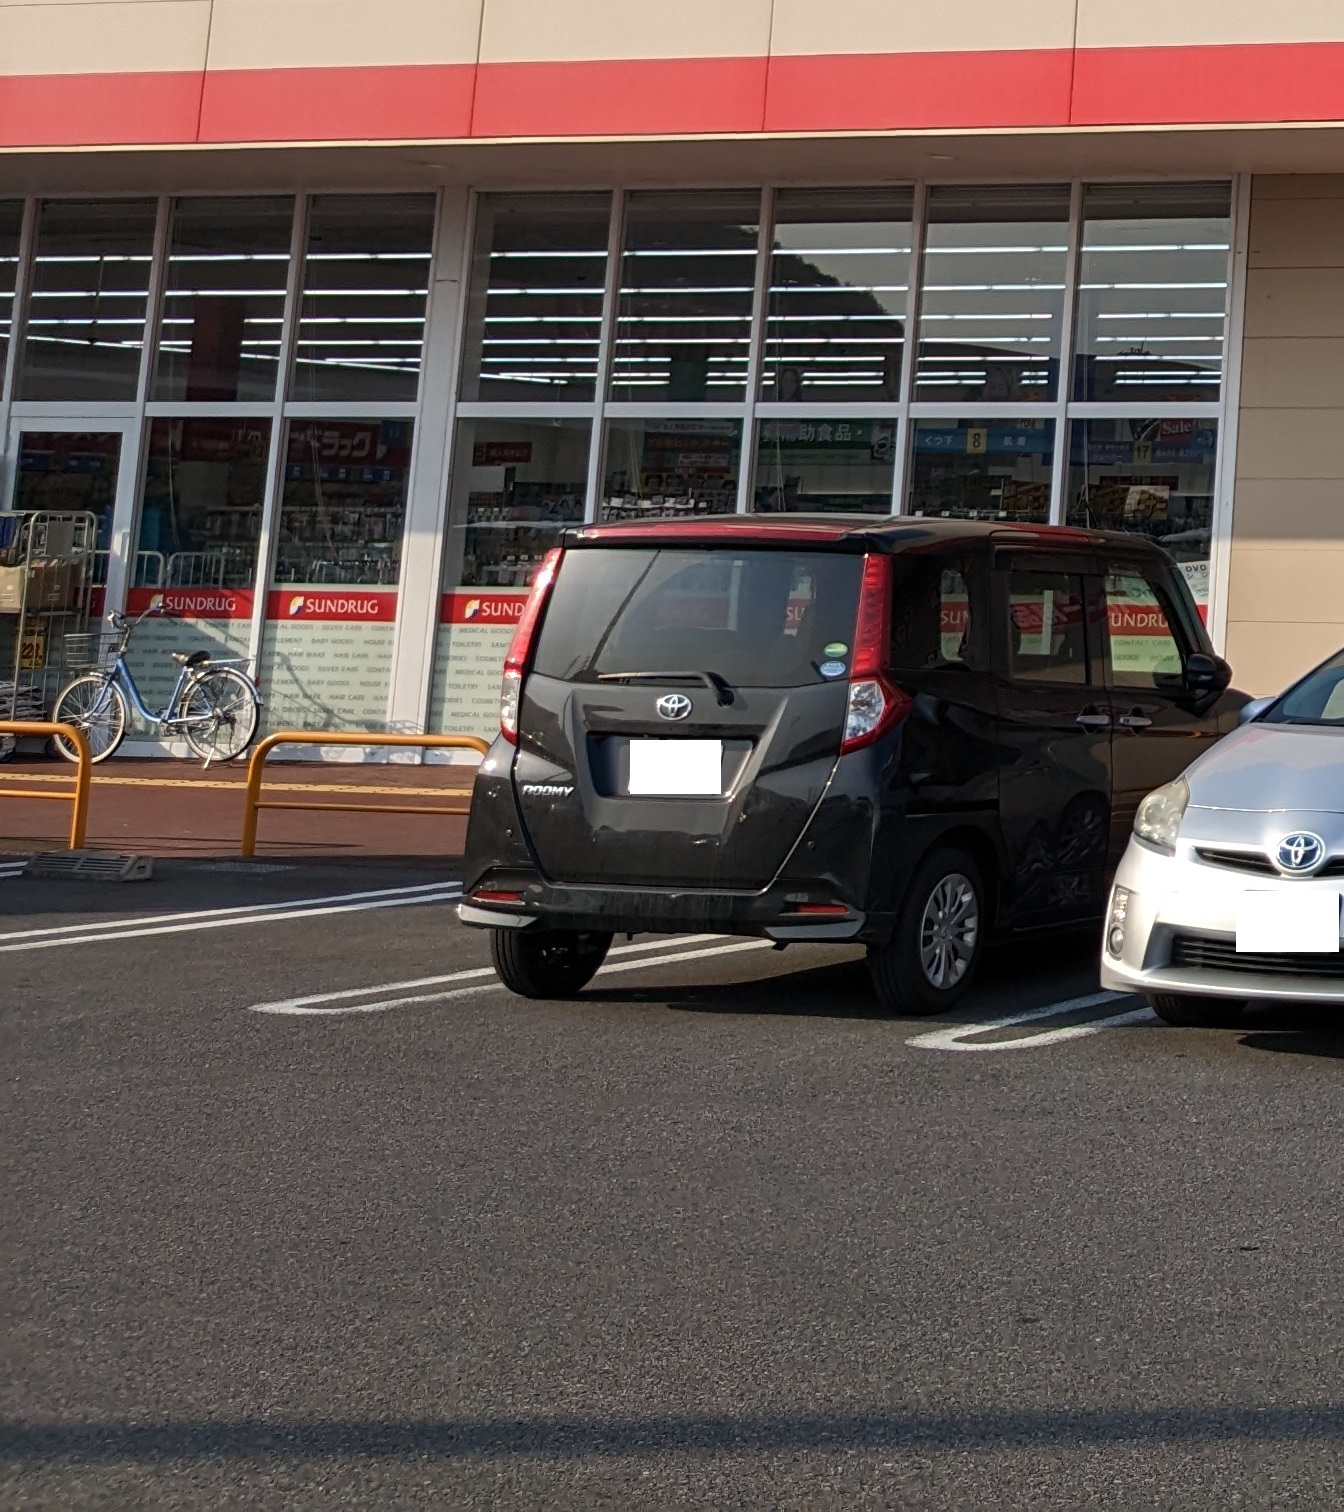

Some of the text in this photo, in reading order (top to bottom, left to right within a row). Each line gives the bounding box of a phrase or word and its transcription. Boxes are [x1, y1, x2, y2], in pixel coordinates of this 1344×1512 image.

[165, 596, 236, 611] SUNDRUG
[306, 598, 379, 613] SUNDRUG
[521, 785, 574, 796] ROOMY
